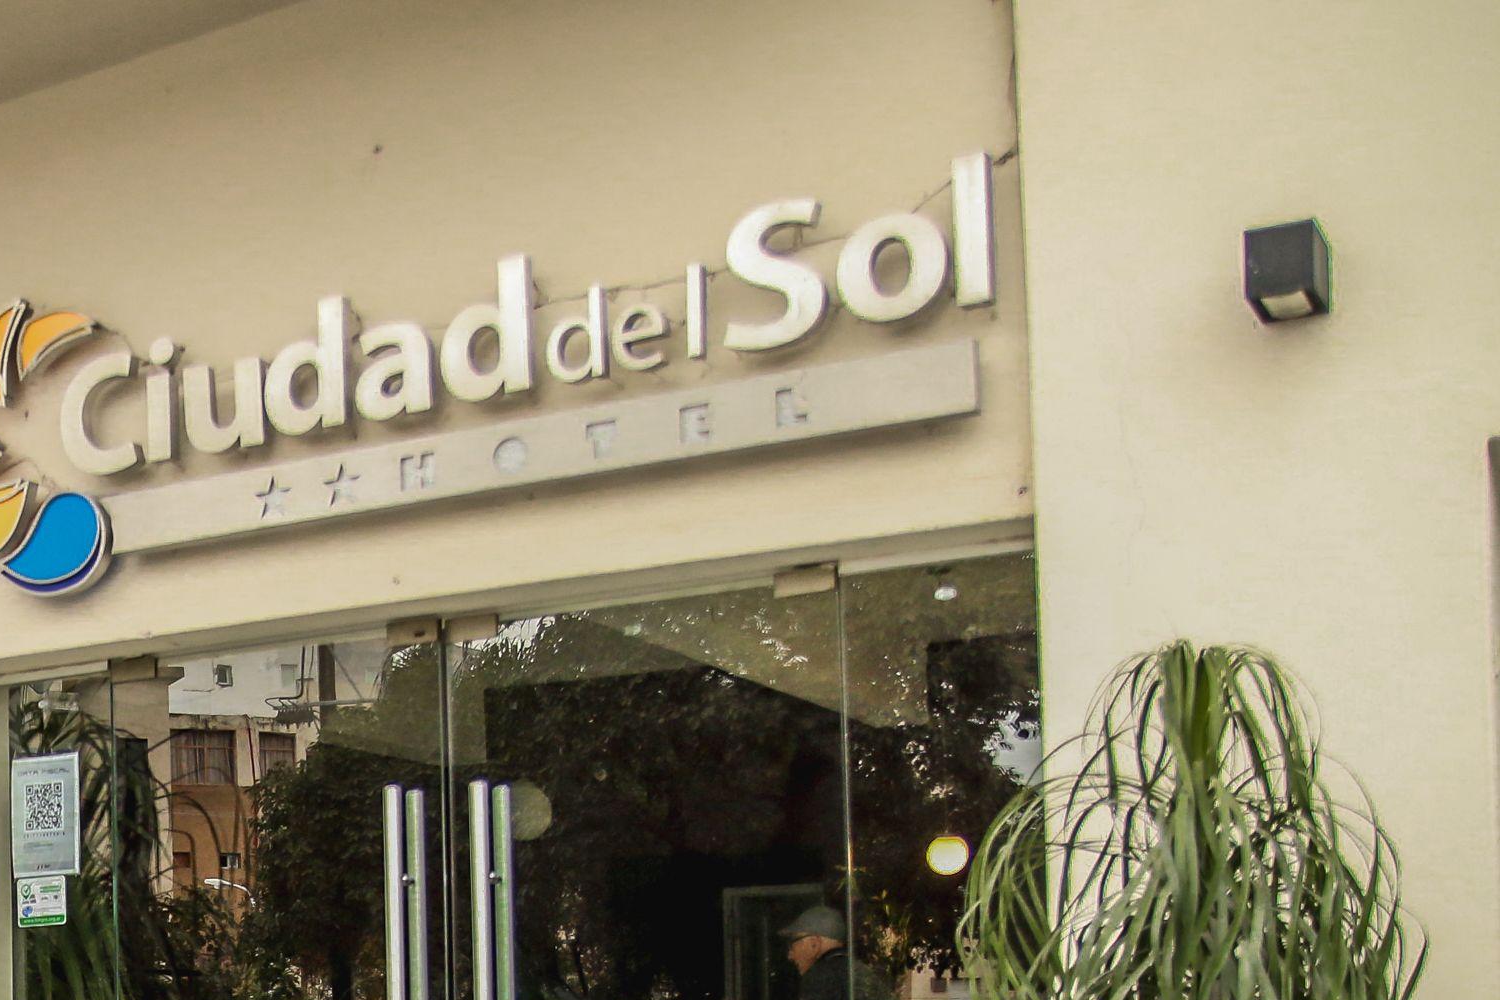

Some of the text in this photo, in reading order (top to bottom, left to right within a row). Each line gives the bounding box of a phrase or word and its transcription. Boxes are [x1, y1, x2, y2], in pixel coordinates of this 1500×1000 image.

[59, 150, 996, 476] Ciudad del Sol
[398, 386, 809, 493] HOTEL
